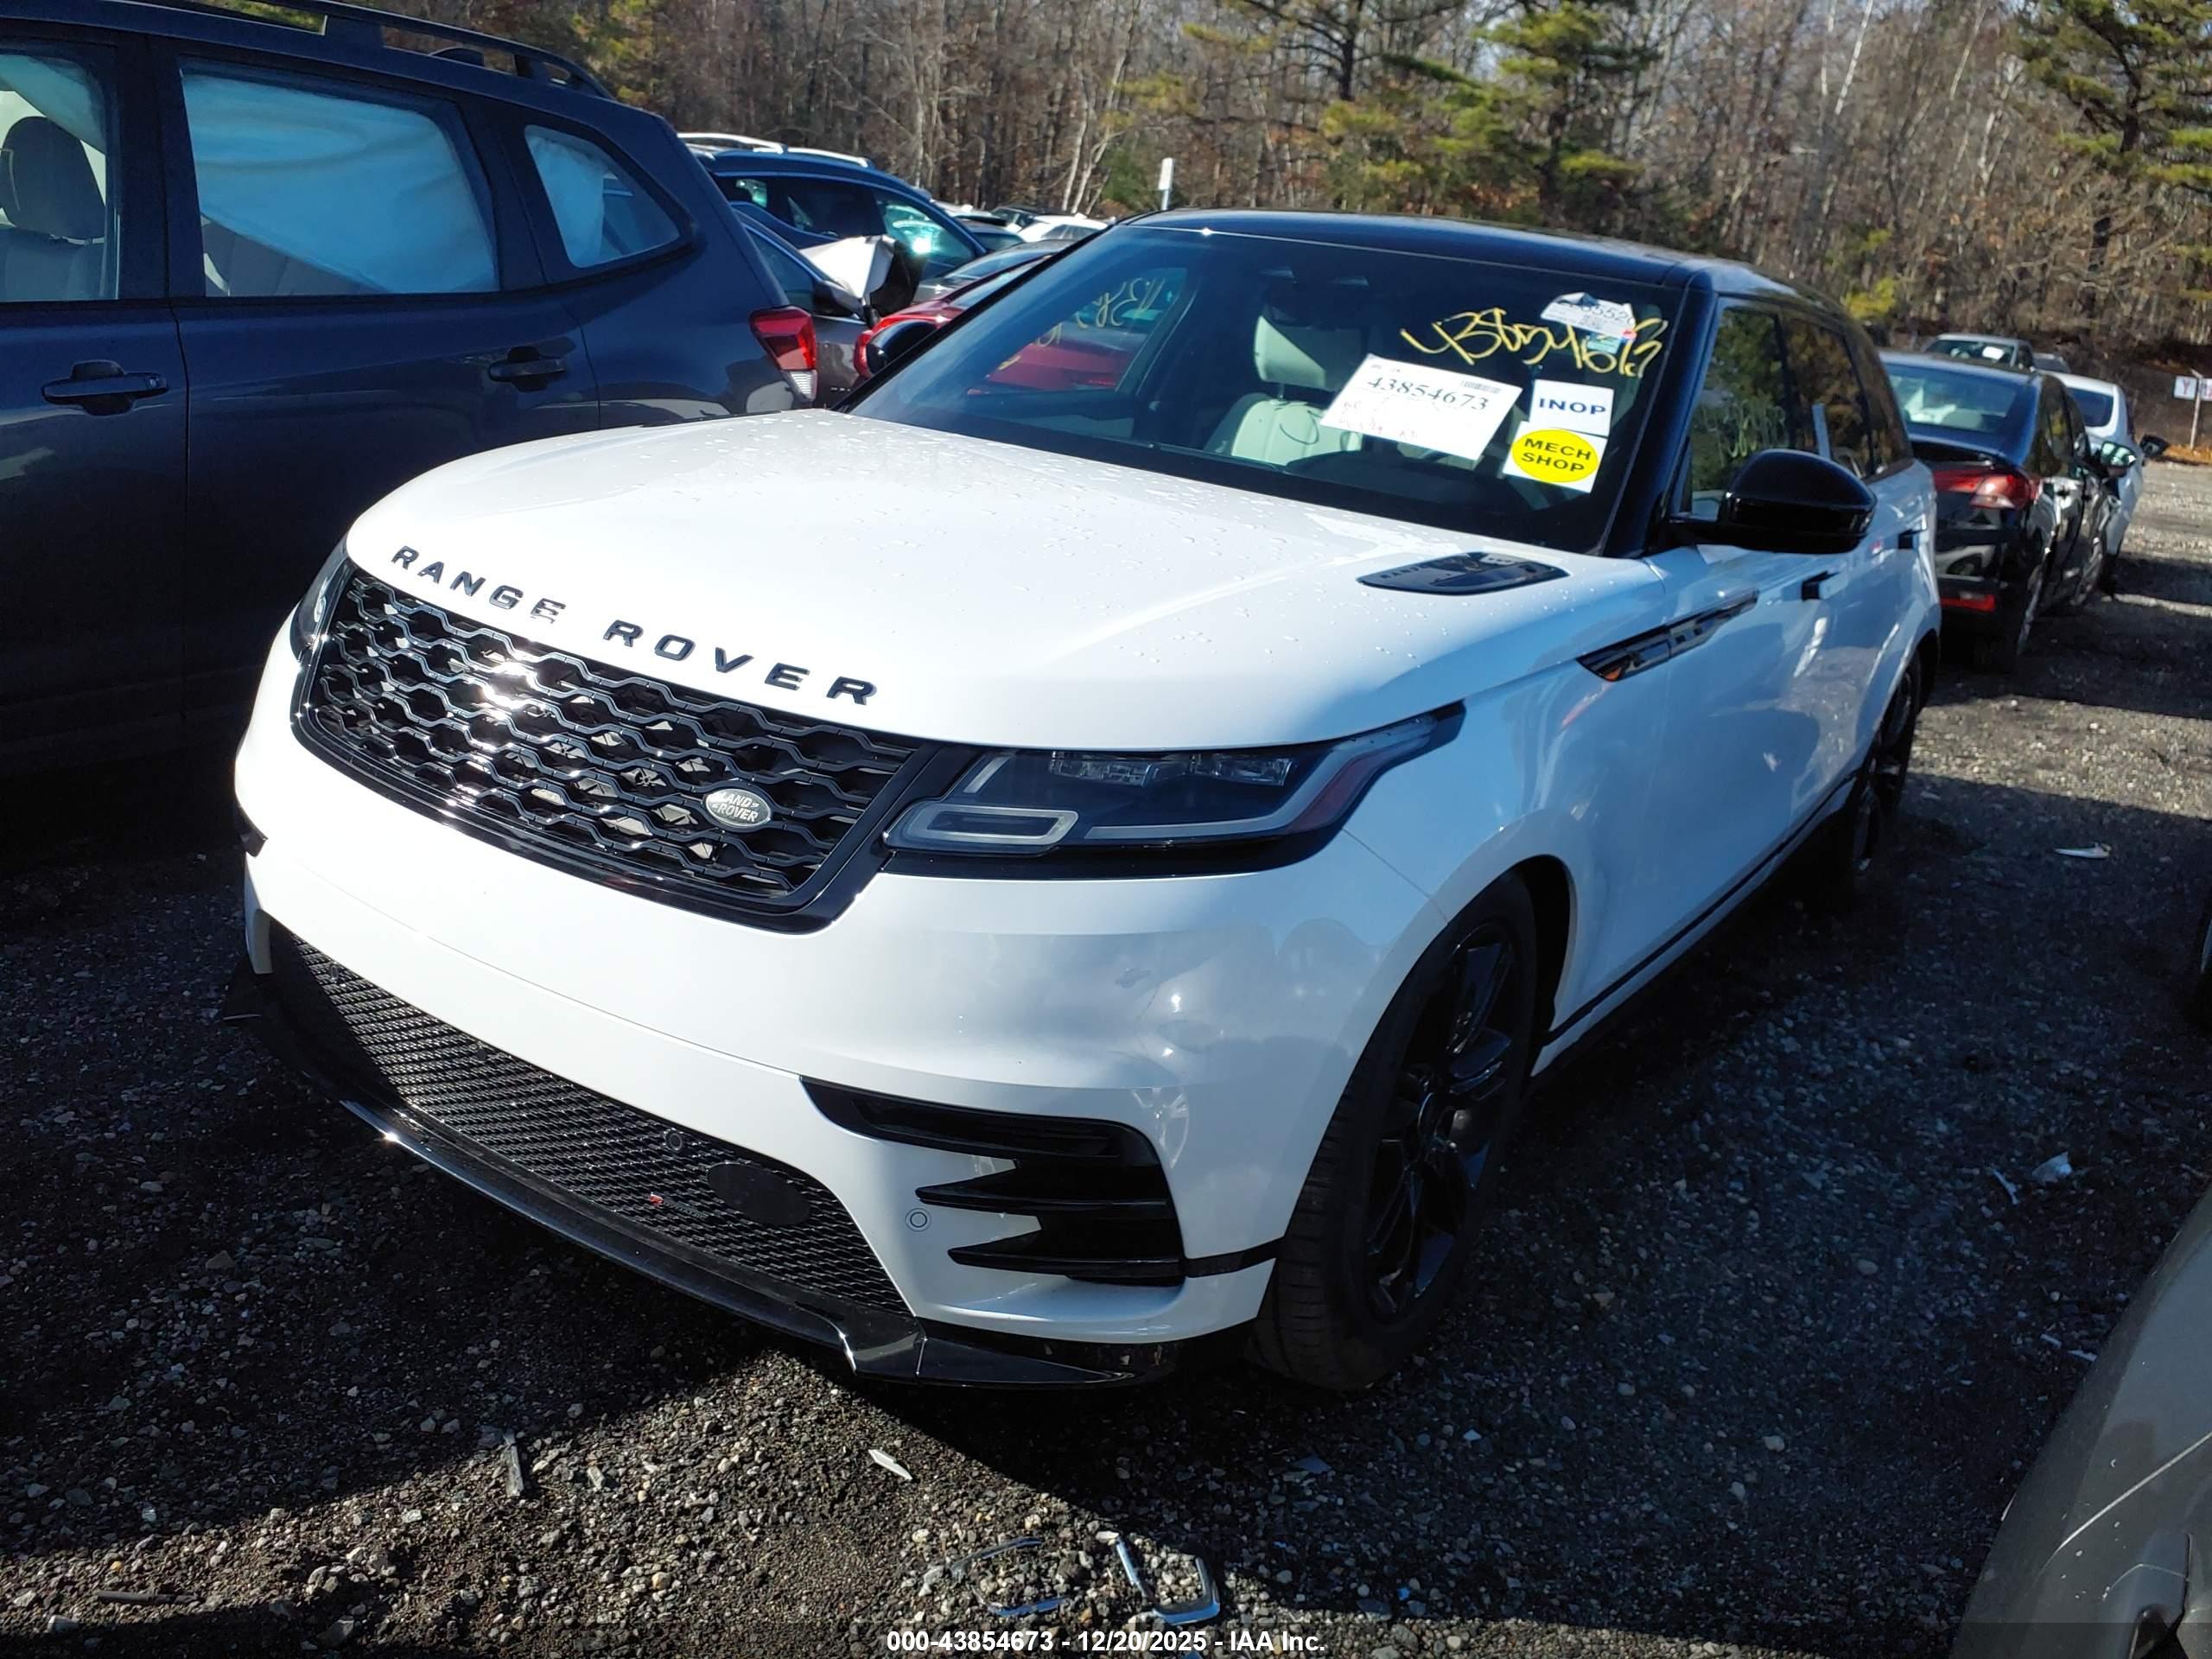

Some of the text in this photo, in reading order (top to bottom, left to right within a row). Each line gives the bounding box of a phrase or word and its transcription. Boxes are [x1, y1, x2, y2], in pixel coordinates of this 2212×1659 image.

[1367, 377, 1489, 410] 43854673
[1539, 397, 1606, 415] INOP
[1524, 438, 1592, 461] MECH
[1521, 452, 1585, 472] SHOP
[391, 545, 878, 706] RANGE ROVER
[720, 791, 753, 808] LAND
[717, 803, 759, 822] ROVER
